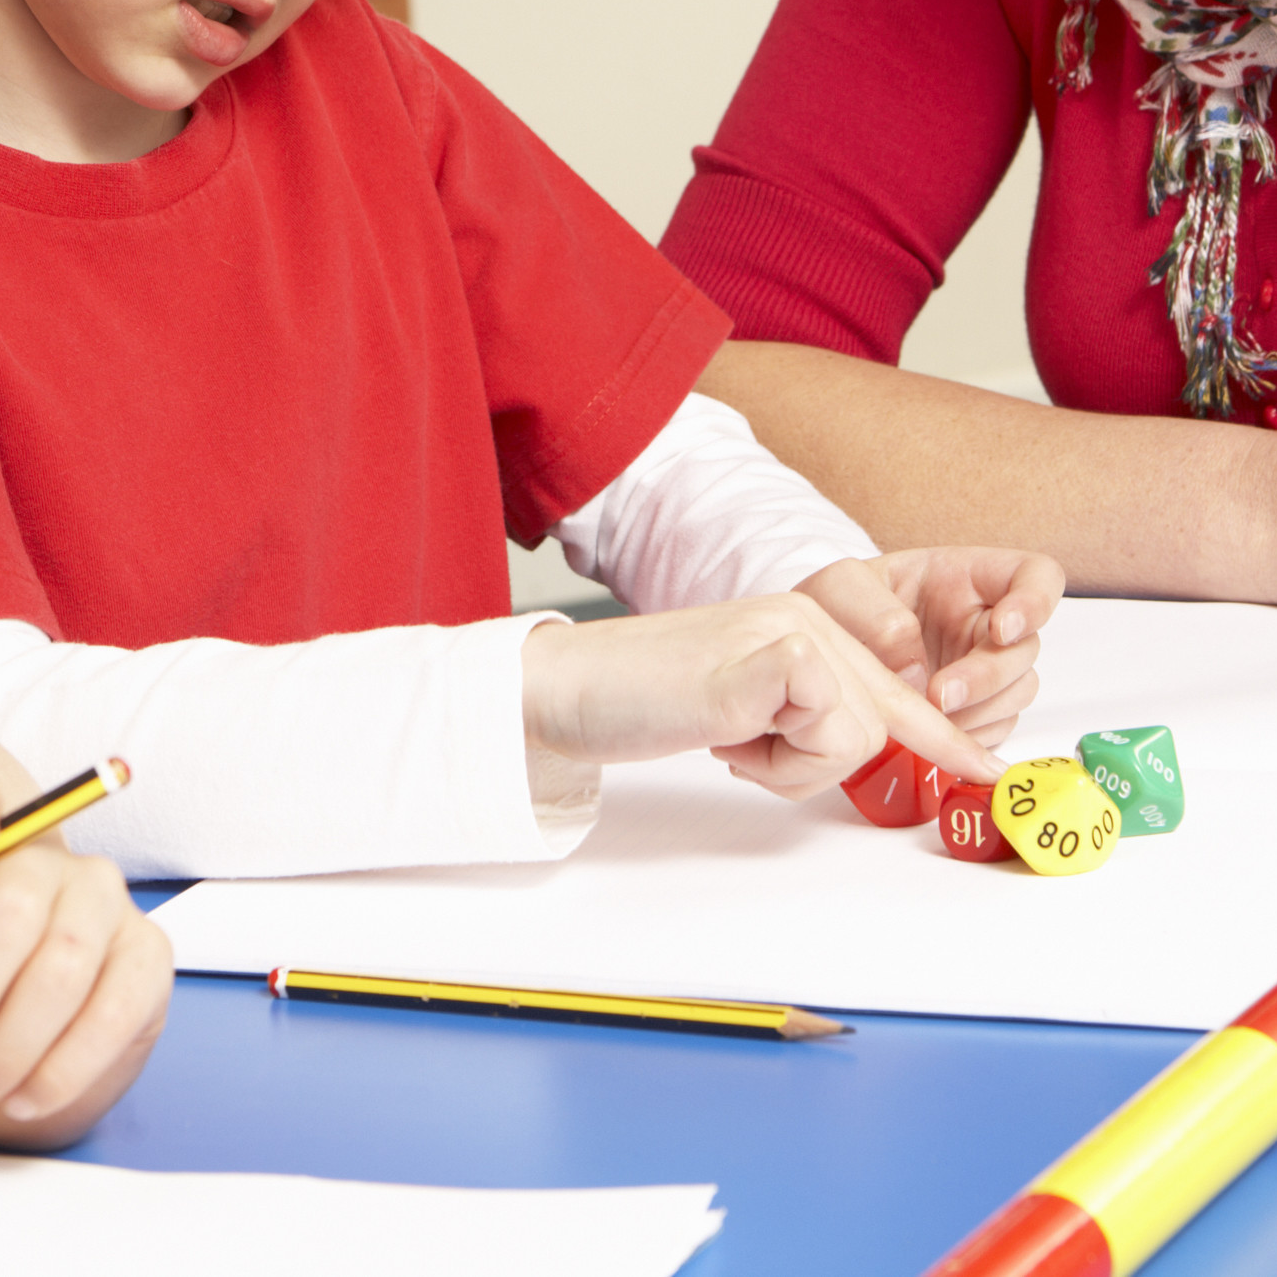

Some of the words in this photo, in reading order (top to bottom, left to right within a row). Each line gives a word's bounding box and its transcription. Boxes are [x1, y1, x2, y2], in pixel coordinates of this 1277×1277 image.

[1094, 765, 1131, 799] 600
[1147, 751, 1175, 783] 100
[1009, 779, 1036, 817] 20
[1139, 804, 1166, 827] 400
[951, 808, 986, 848] 16
[1037, 821, 1079, 858] 80
[1092, 809, 1114, 850] 00
